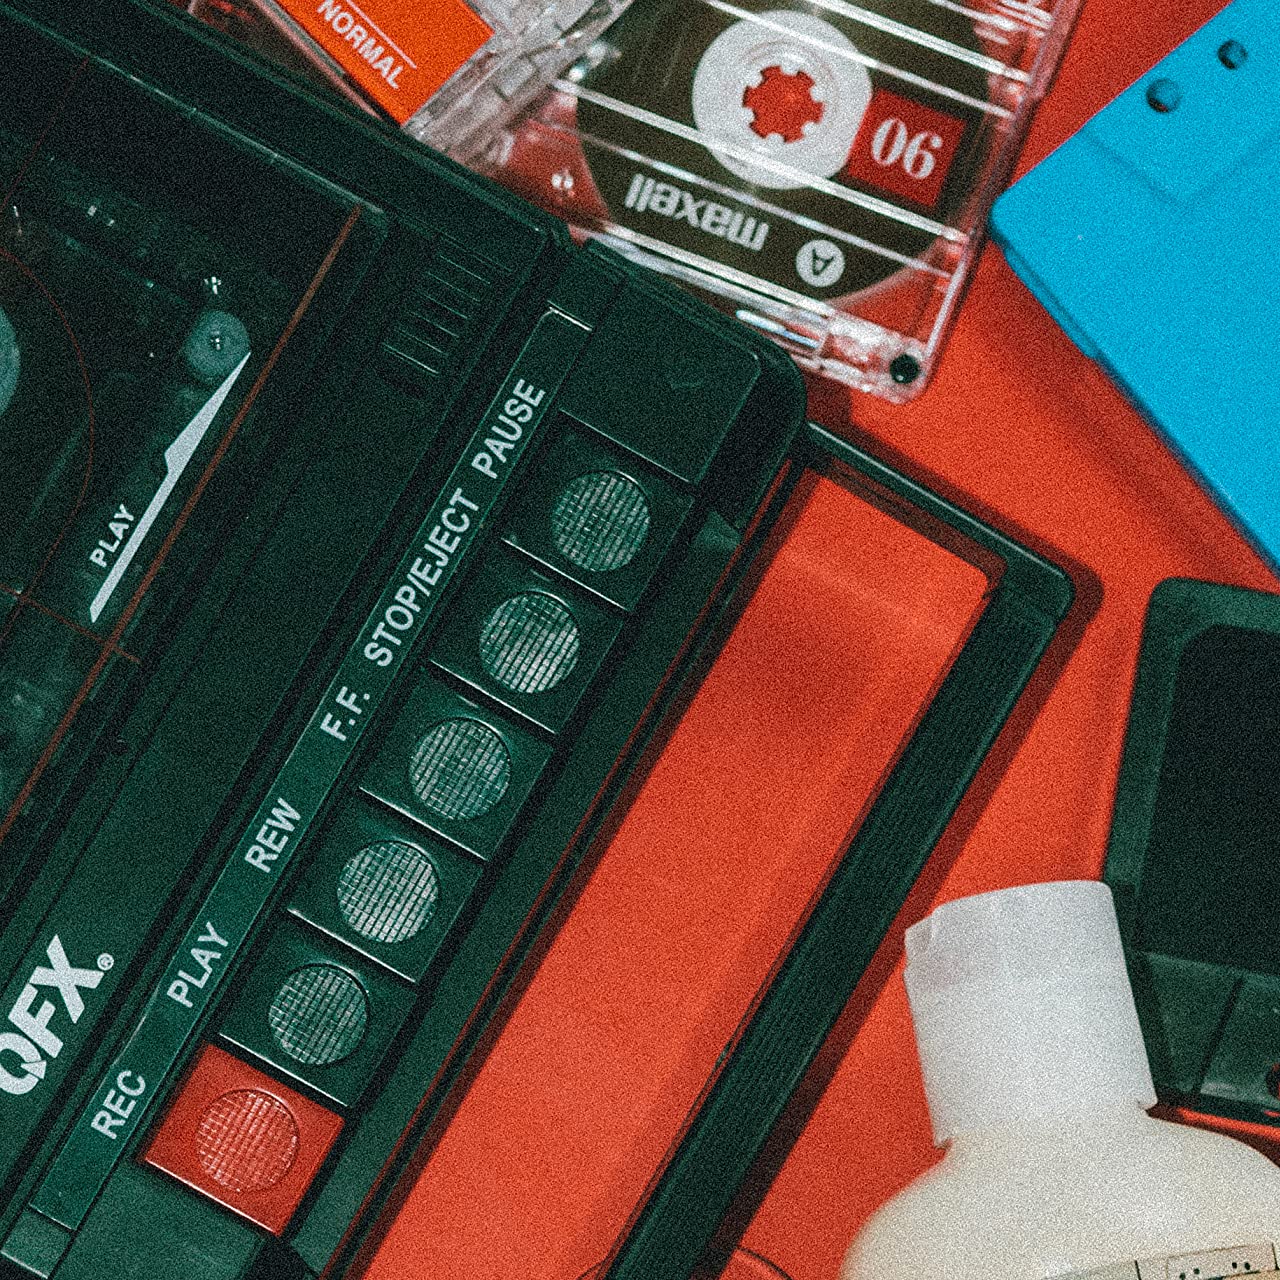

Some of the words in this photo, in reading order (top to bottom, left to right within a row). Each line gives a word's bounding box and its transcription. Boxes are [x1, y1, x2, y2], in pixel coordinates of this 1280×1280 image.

[316, 0, 405, 90] NORMAL
[871, 117, 944, 180] 90
[625, 173, 770, 251] maxell
[809, 248, 837, 277] A
[471, 379, 547, 480] PAUSE
[88, 503, 135, 569] PLAY
[363, 487, 481, 667] STOP/EJECT
[320, 685, 371, 742] F.F.
[244, 798, 301, 872] REW
[166, 922, 230, 1008] PLAY
[91, 1068, 147, 1140] REC
